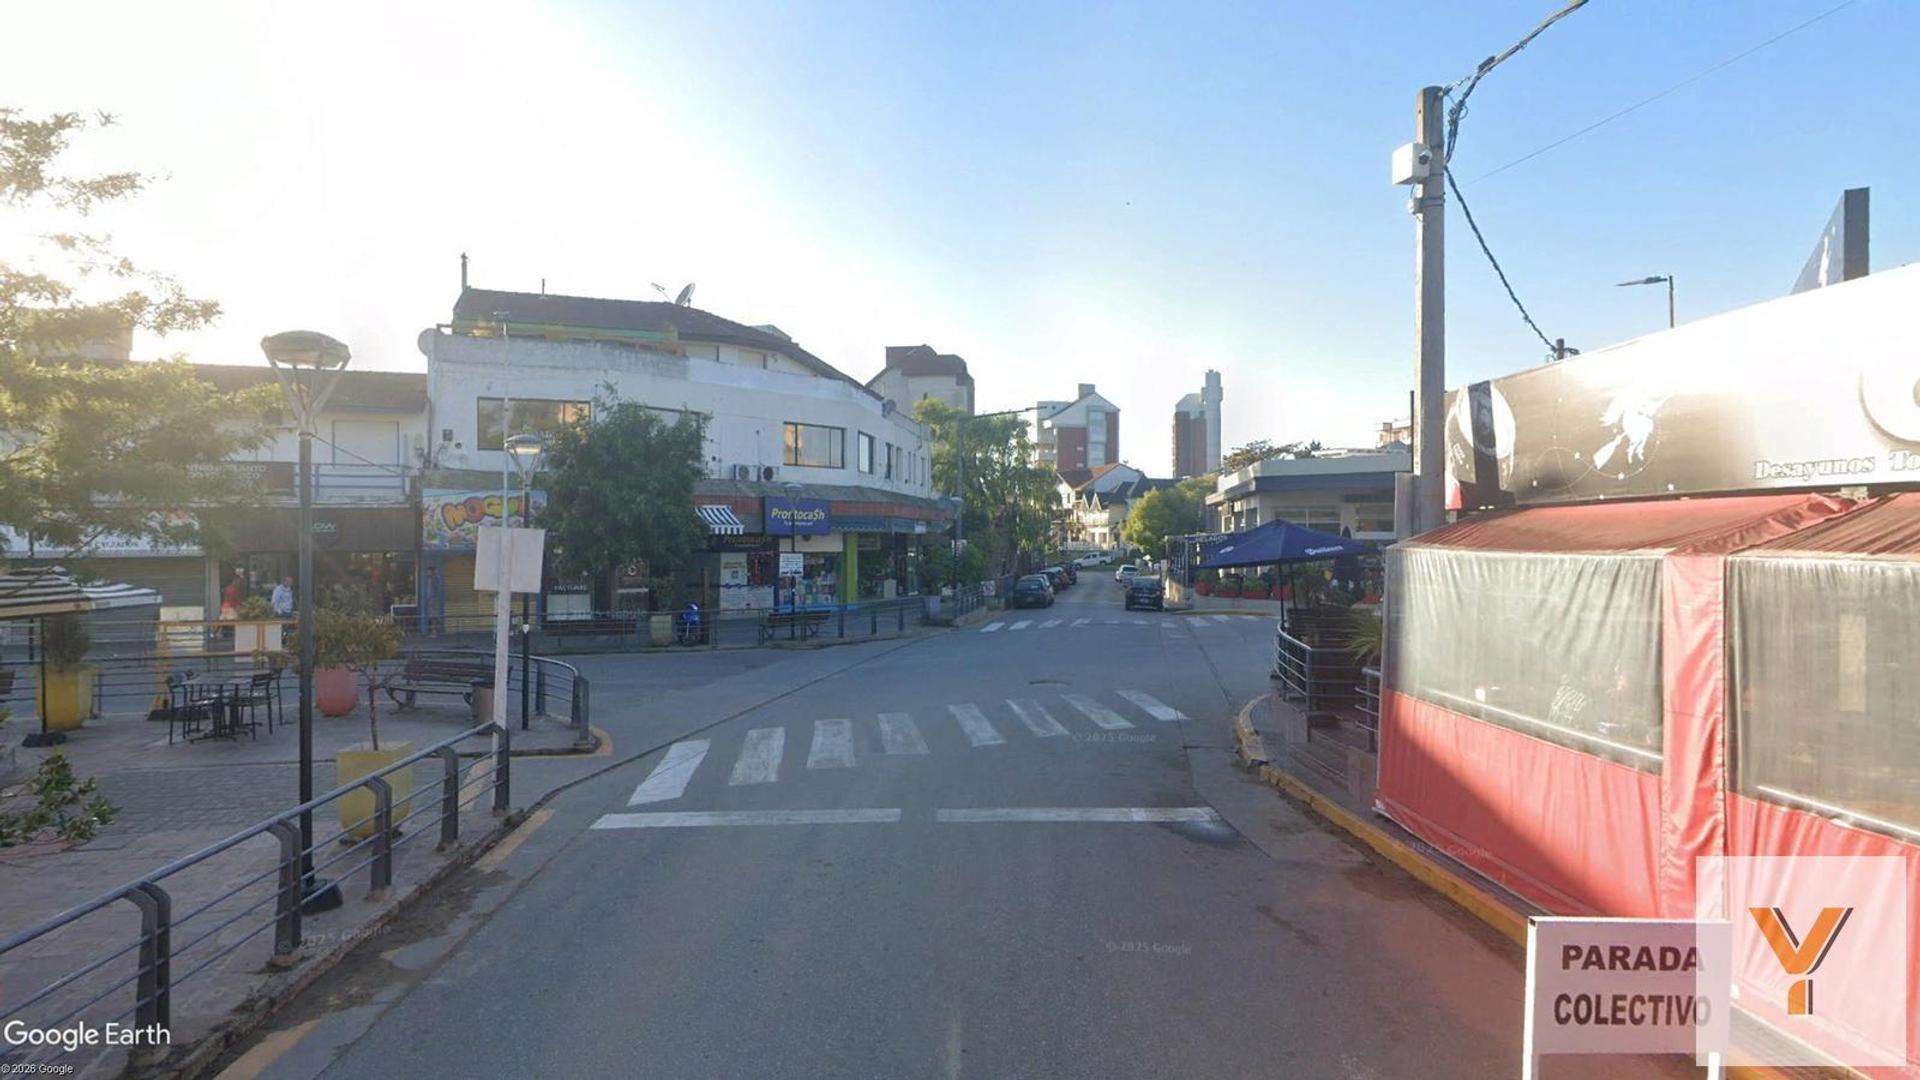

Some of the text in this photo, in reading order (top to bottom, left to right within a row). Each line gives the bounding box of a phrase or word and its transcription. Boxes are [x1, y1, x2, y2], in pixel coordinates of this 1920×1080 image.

[1754, 455, 1876, 482] Desayunos
[1561, 944, 1704, 971] PARADA
[1554, 993, 1712, 1026] COLECTIVO
